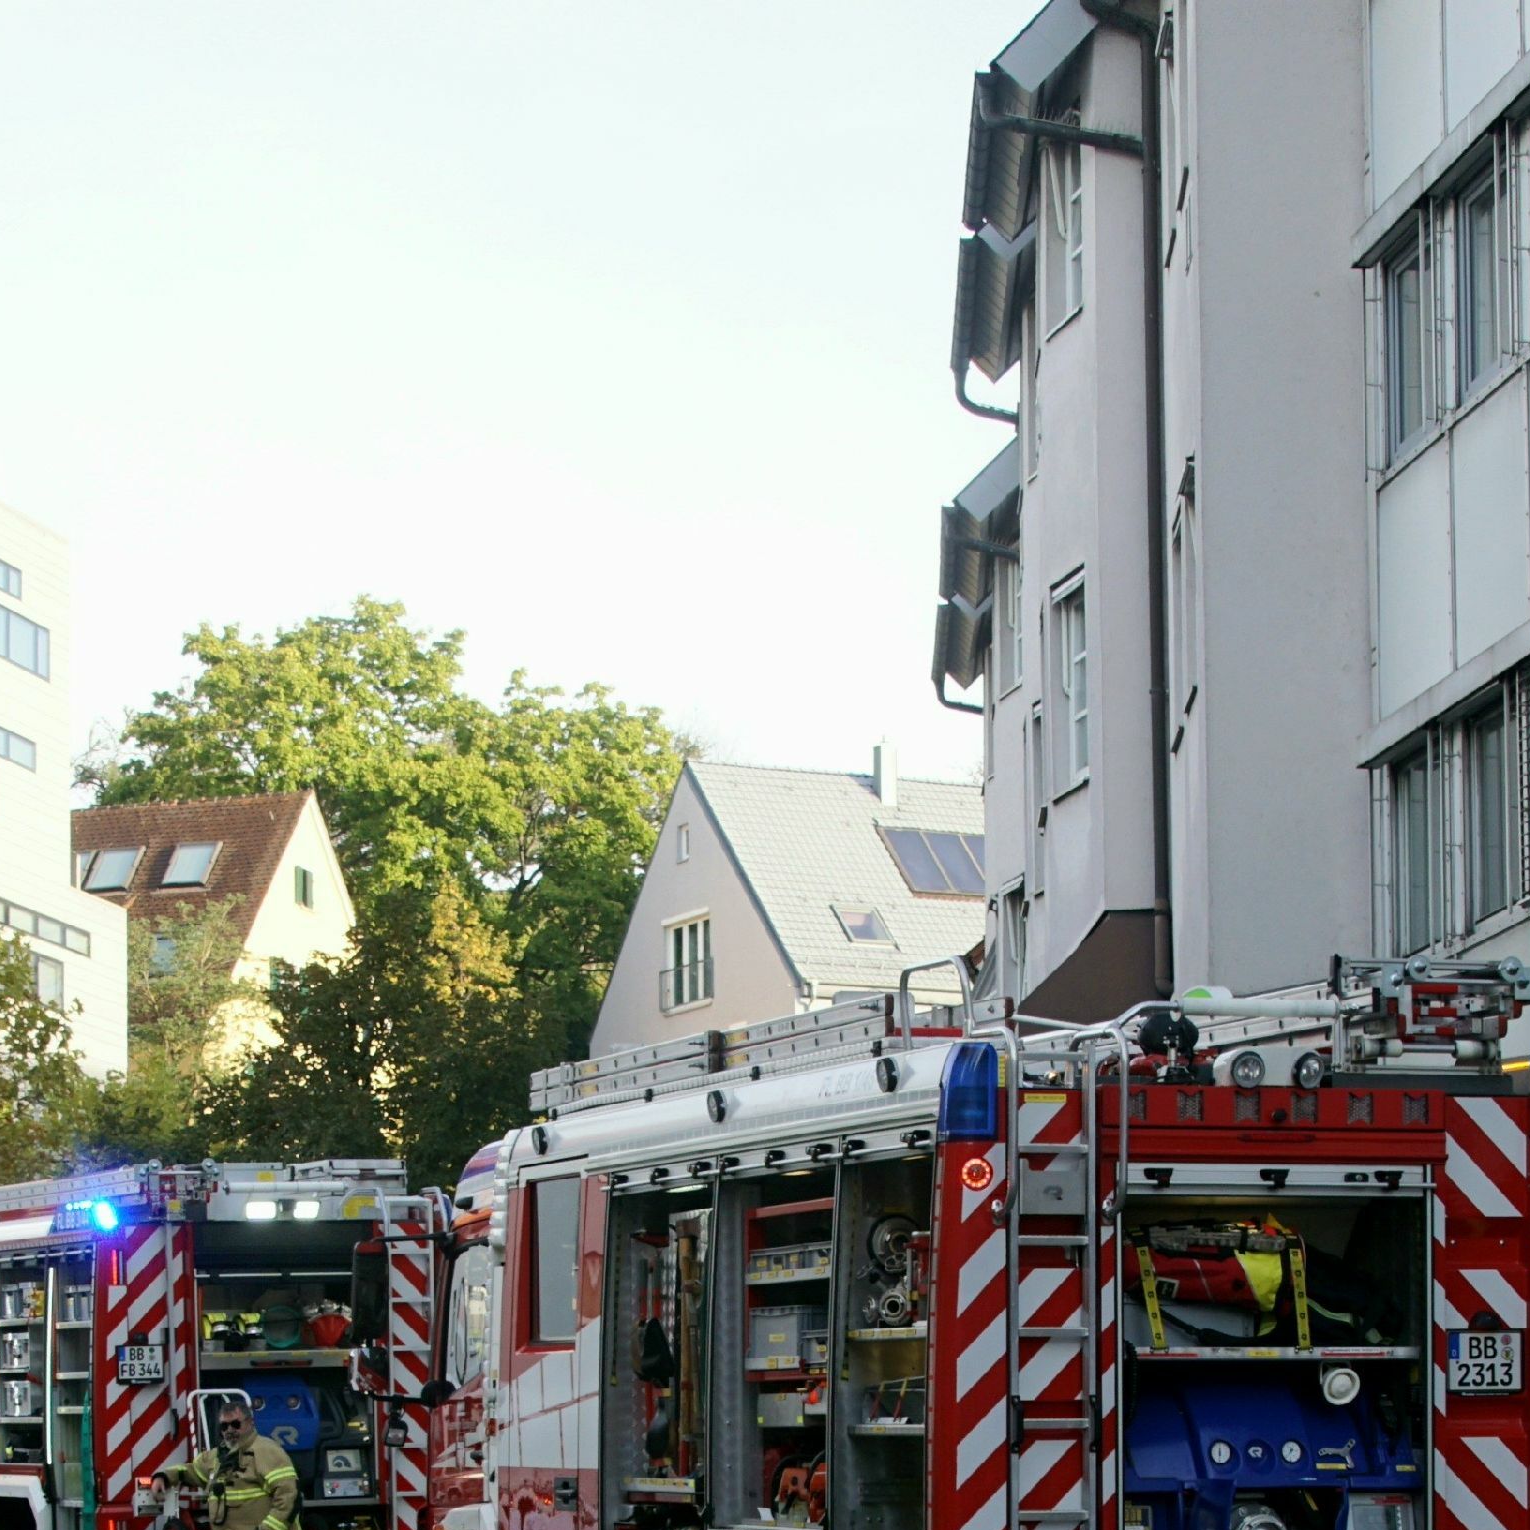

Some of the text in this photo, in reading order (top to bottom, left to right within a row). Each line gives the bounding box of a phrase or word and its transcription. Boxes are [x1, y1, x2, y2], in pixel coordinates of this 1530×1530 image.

[129, 1347, 145, 1361] BB
[1468, 1336, 1498, 1359] BB
[120, 1363, 161, 1377] FB 344
[1458, 1363, 1513, 1387] 2313
